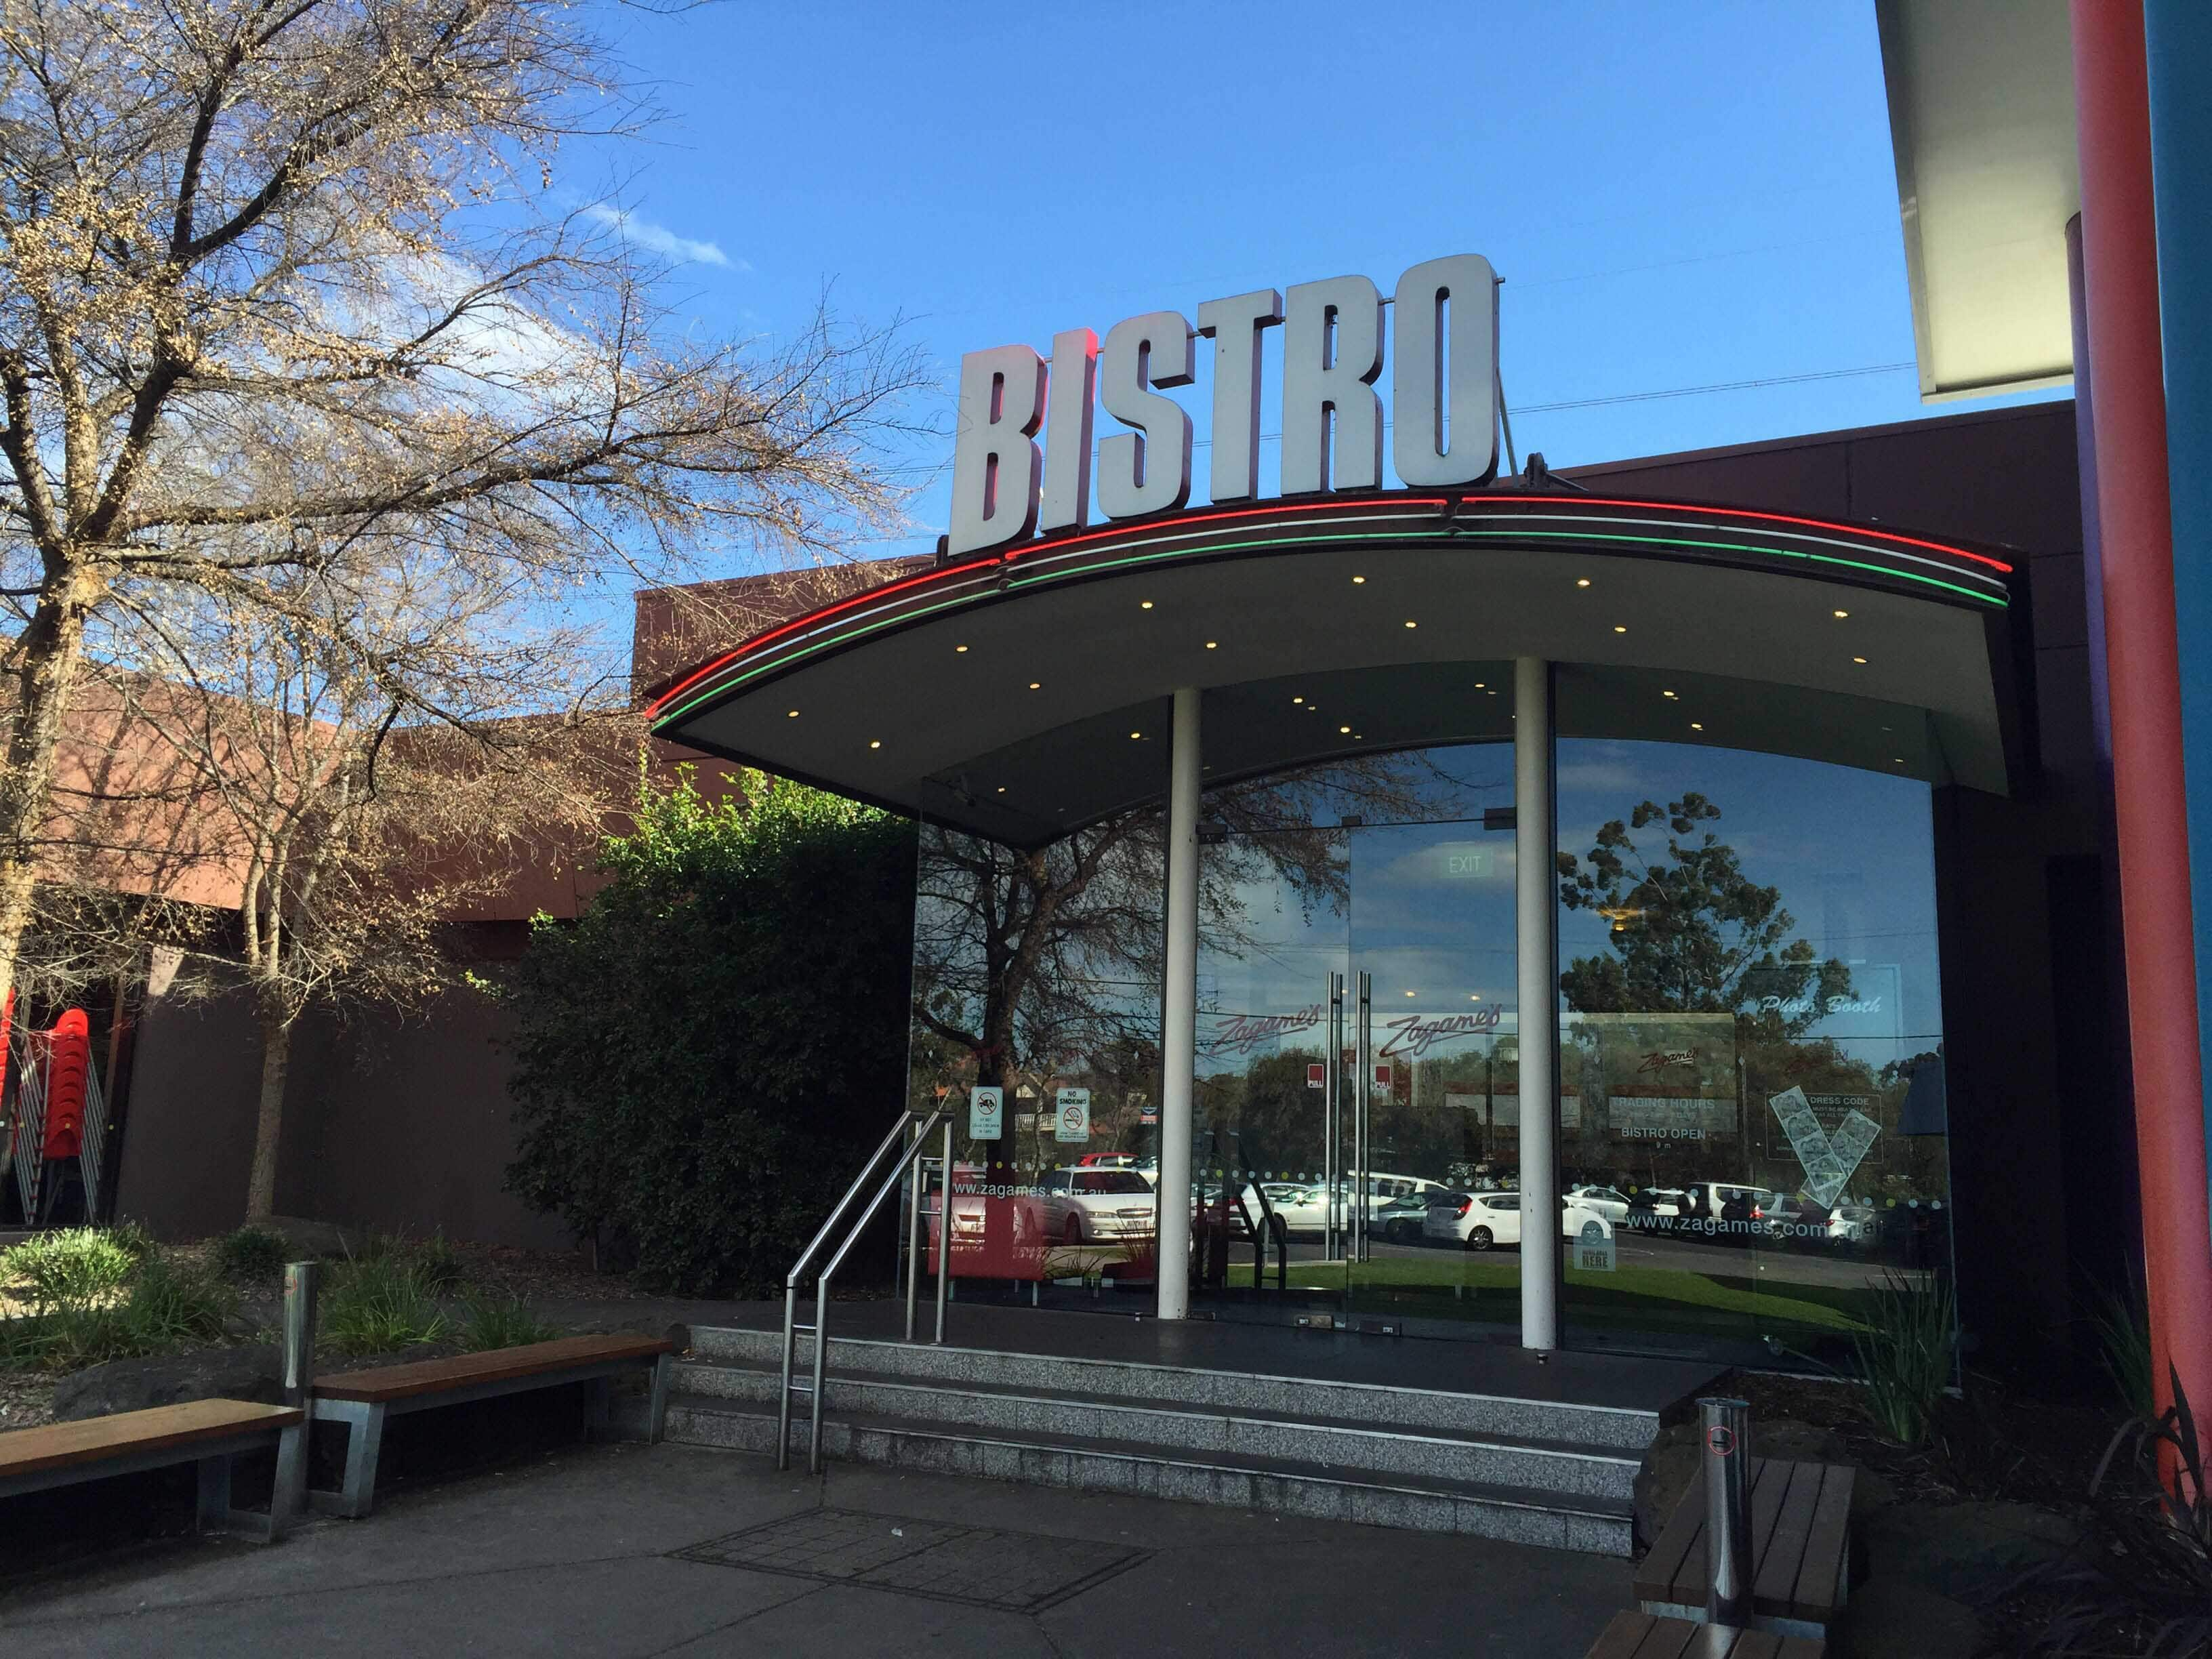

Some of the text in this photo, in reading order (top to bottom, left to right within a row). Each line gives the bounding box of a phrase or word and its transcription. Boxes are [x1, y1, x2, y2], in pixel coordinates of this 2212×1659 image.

[947, 253, 1500, 557] BISTRO
[1449, 855, 1481, 873] EXIT
[1761, 995, 1881, 1014] Photo Booth
[1209, 1004, 1320, 1055] Zagame's
[1379, 1003, 1502, 1057] Zagame's
[1670, 1098, 1715, 1109] HOURS
[1810, 1097, 1869, 1105] DRESS CODE
[1621, 1128, 1706, 1140] BISTRO OPEN
[952, 1182, 1106, 1199] ww.zagames.comau
[1626, 1214, 1862, 1239] www.zagamescomau
[1582, 1256, 1608, 1267] HERE
